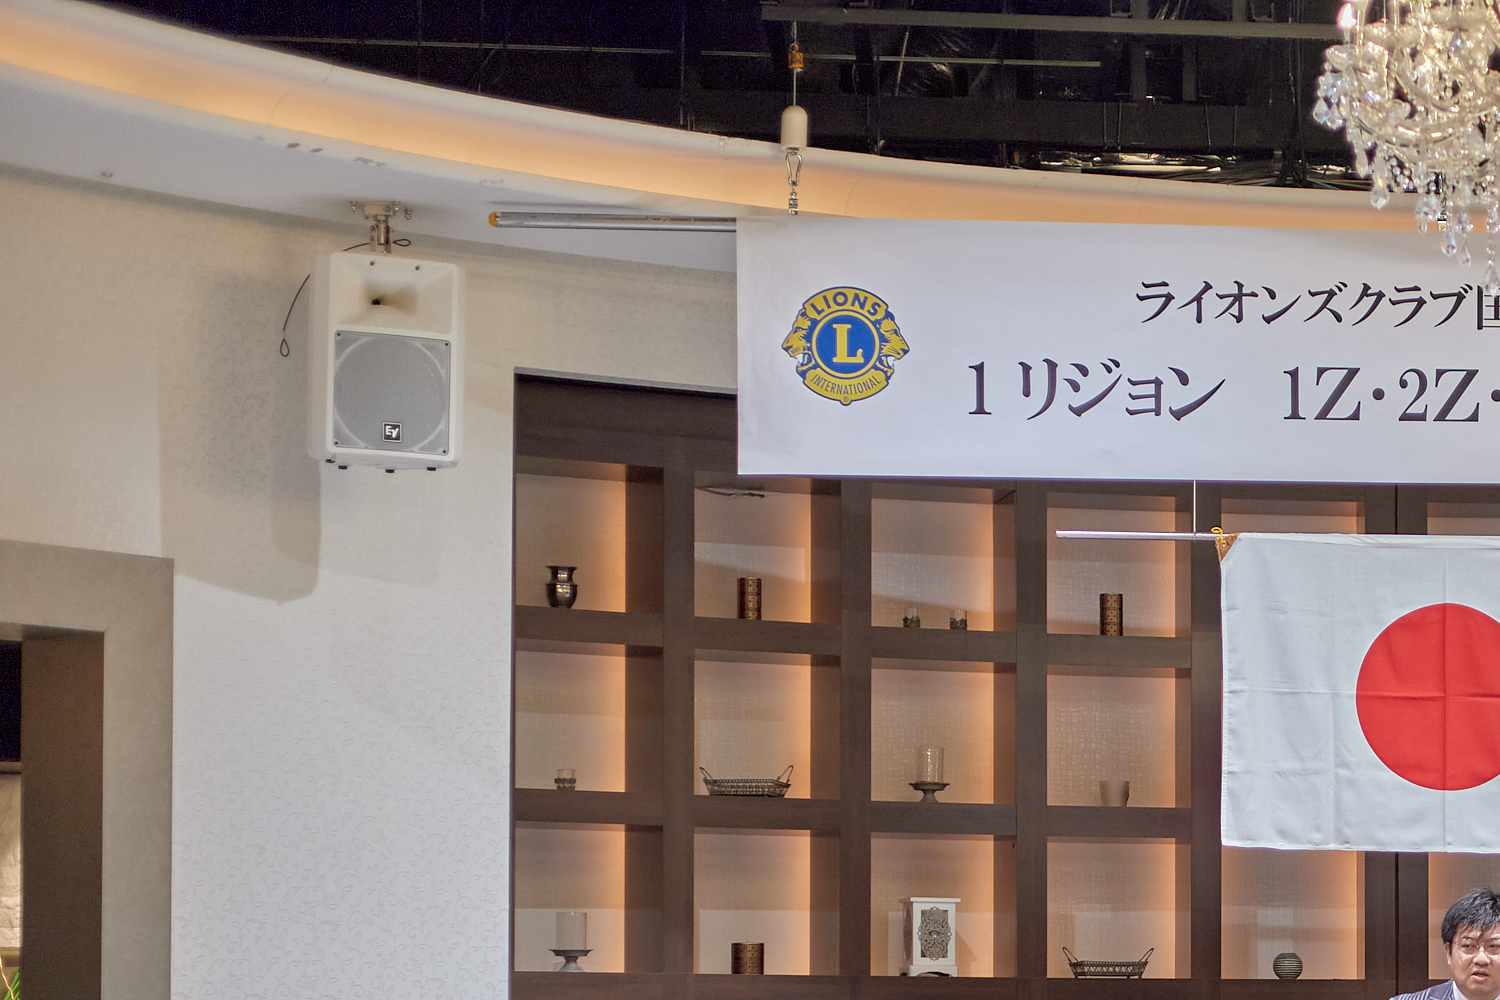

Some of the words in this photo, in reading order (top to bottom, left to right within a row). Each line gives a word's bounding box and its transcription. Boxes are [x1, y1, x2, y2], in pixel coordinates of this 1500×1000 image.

[809, 291, 882, 317] LIONS
[832, 323, 865, 363] L
[810, 373, 882, 396] INTERNATIONAL
